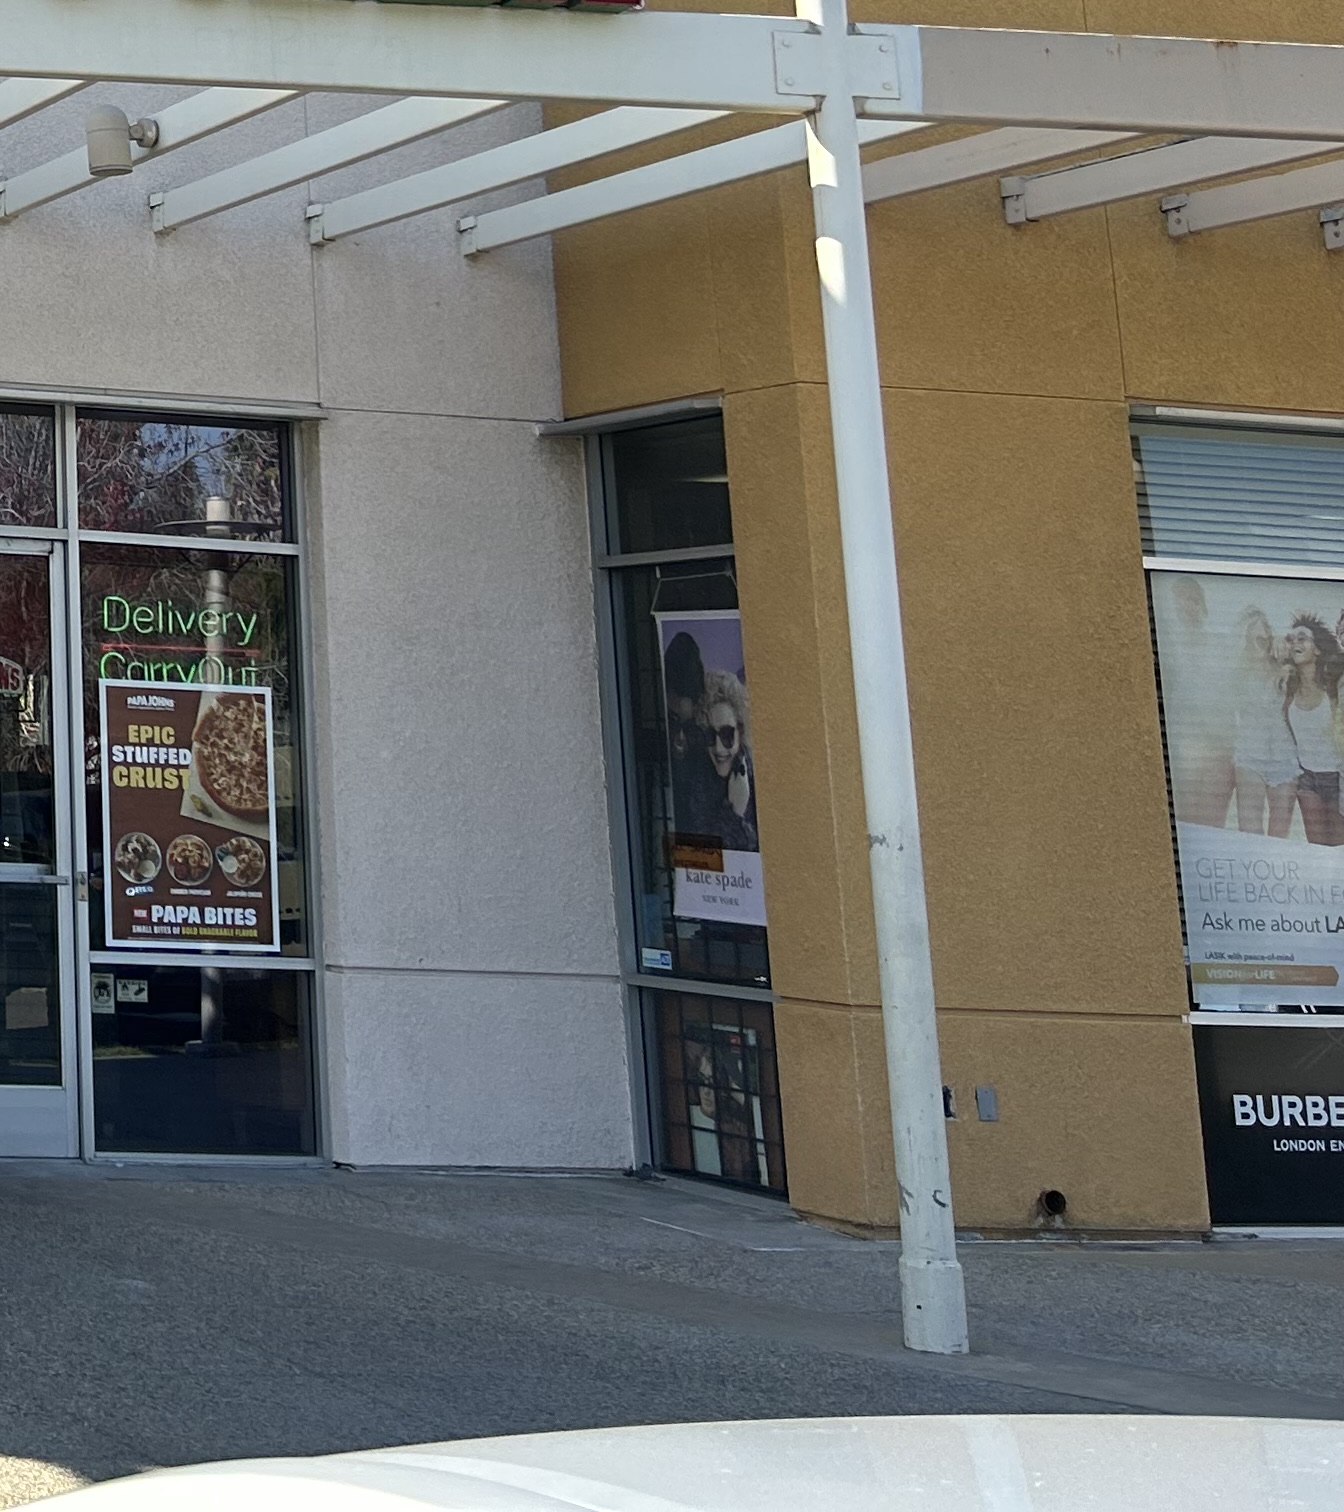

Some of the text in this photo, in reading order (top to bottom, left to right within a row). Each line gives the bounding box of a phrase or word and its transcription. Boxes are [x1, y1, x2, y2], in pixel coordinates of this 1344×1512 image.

[103, 595, 257, 646] Delivery
[128, 724, 175, 744] EPIC
[112, 745, 192, 765] STUFFED
[112, 765, 190, 790] CRUST
[1196, 858, 1300, 881] GET YOUR
[686, 870, 752, 891] kate spade
[1198, 882, 1239, 903] LIFE
[1245, 884, 1299, 904] BACK
[1304, 885, 1324, 904] IN
[151, 905, 201, 924] PAPA
[204, 907, 257, 925] BITES
[1202, 912, 1233, 931] Ask
[1239, 919, 1265, 932] me
[1271, 914, 1322, 933] about
[1273, 1139, 1325, 1152] LONDON
